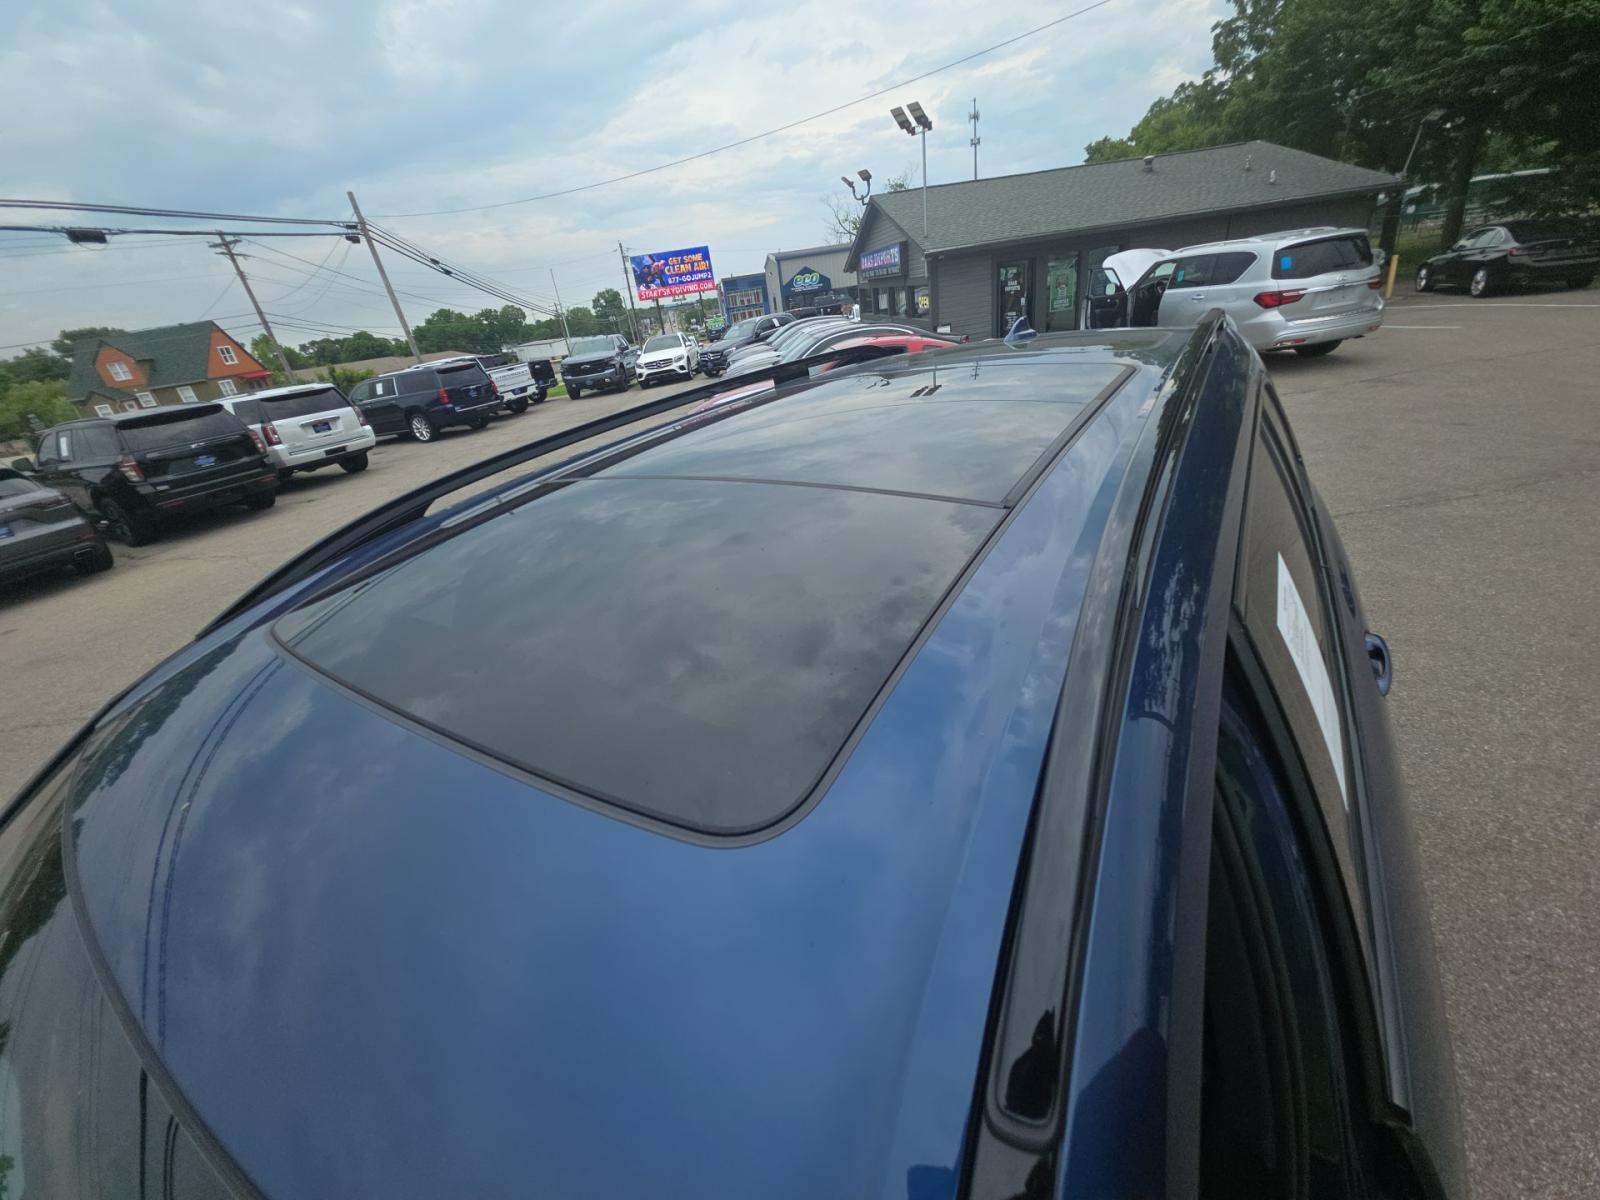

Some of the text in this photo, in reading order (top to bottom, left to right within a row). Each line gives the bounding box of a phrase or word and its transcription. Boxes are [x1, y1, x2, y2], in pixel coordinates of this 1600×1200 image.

[668, 253, 703, 265] GET SOME
[664, 261, 709, 275] CLEAN AIR!
[640, 282, 714, 299] STARTSKYDIVING.COM
